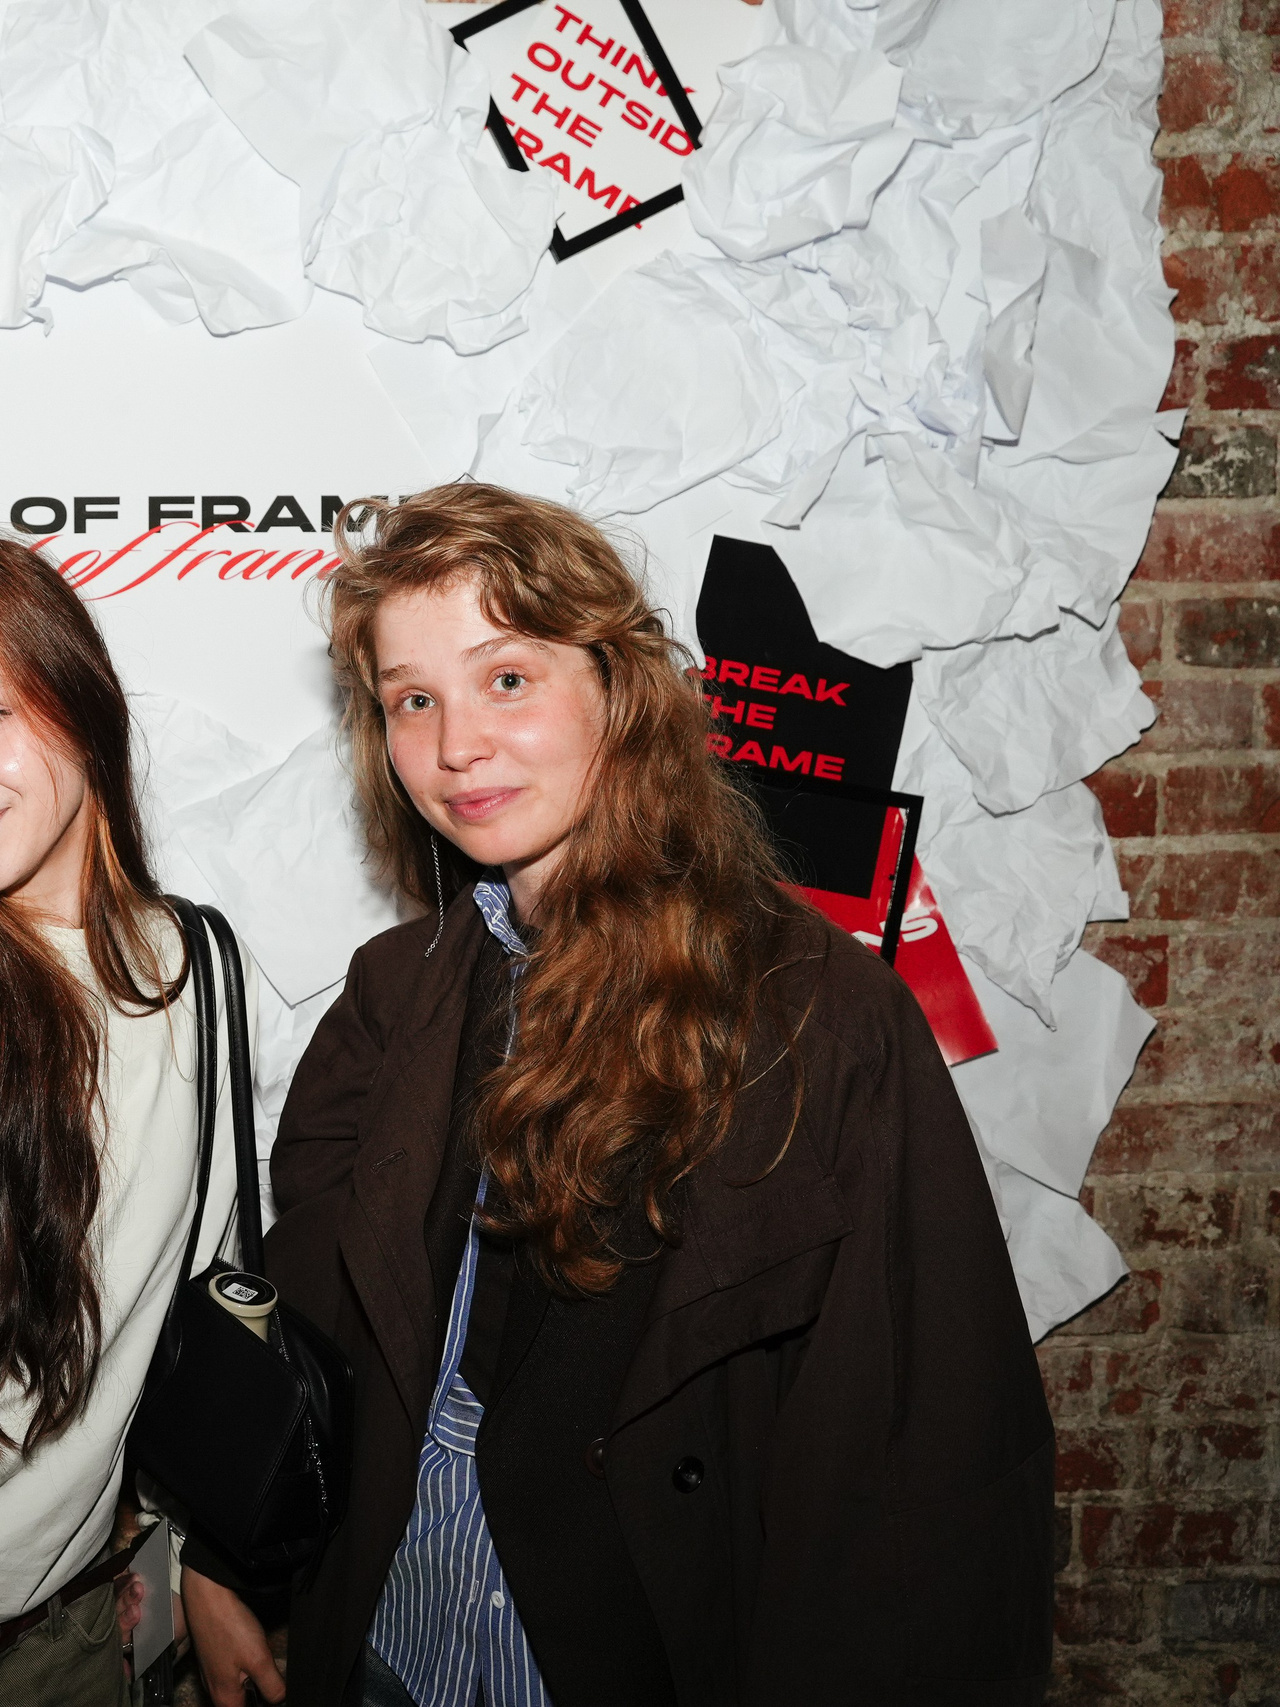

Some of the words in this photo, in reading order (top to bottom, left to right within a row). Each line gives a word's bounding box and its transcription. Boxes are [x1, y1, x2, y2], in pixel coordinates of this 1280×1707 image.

[554, 4, 698, 97] THIN
[510, 72, 603, 149] THE
[526, 41, 696, 157] OUTSID
[484, 114, 643, 230] RAM
[10, 496, 121, 535] OF
[148, 495, 414, 534] FRAM
[82, 520, 346, 601] fram
[705, 732, 846, 782] RAME
